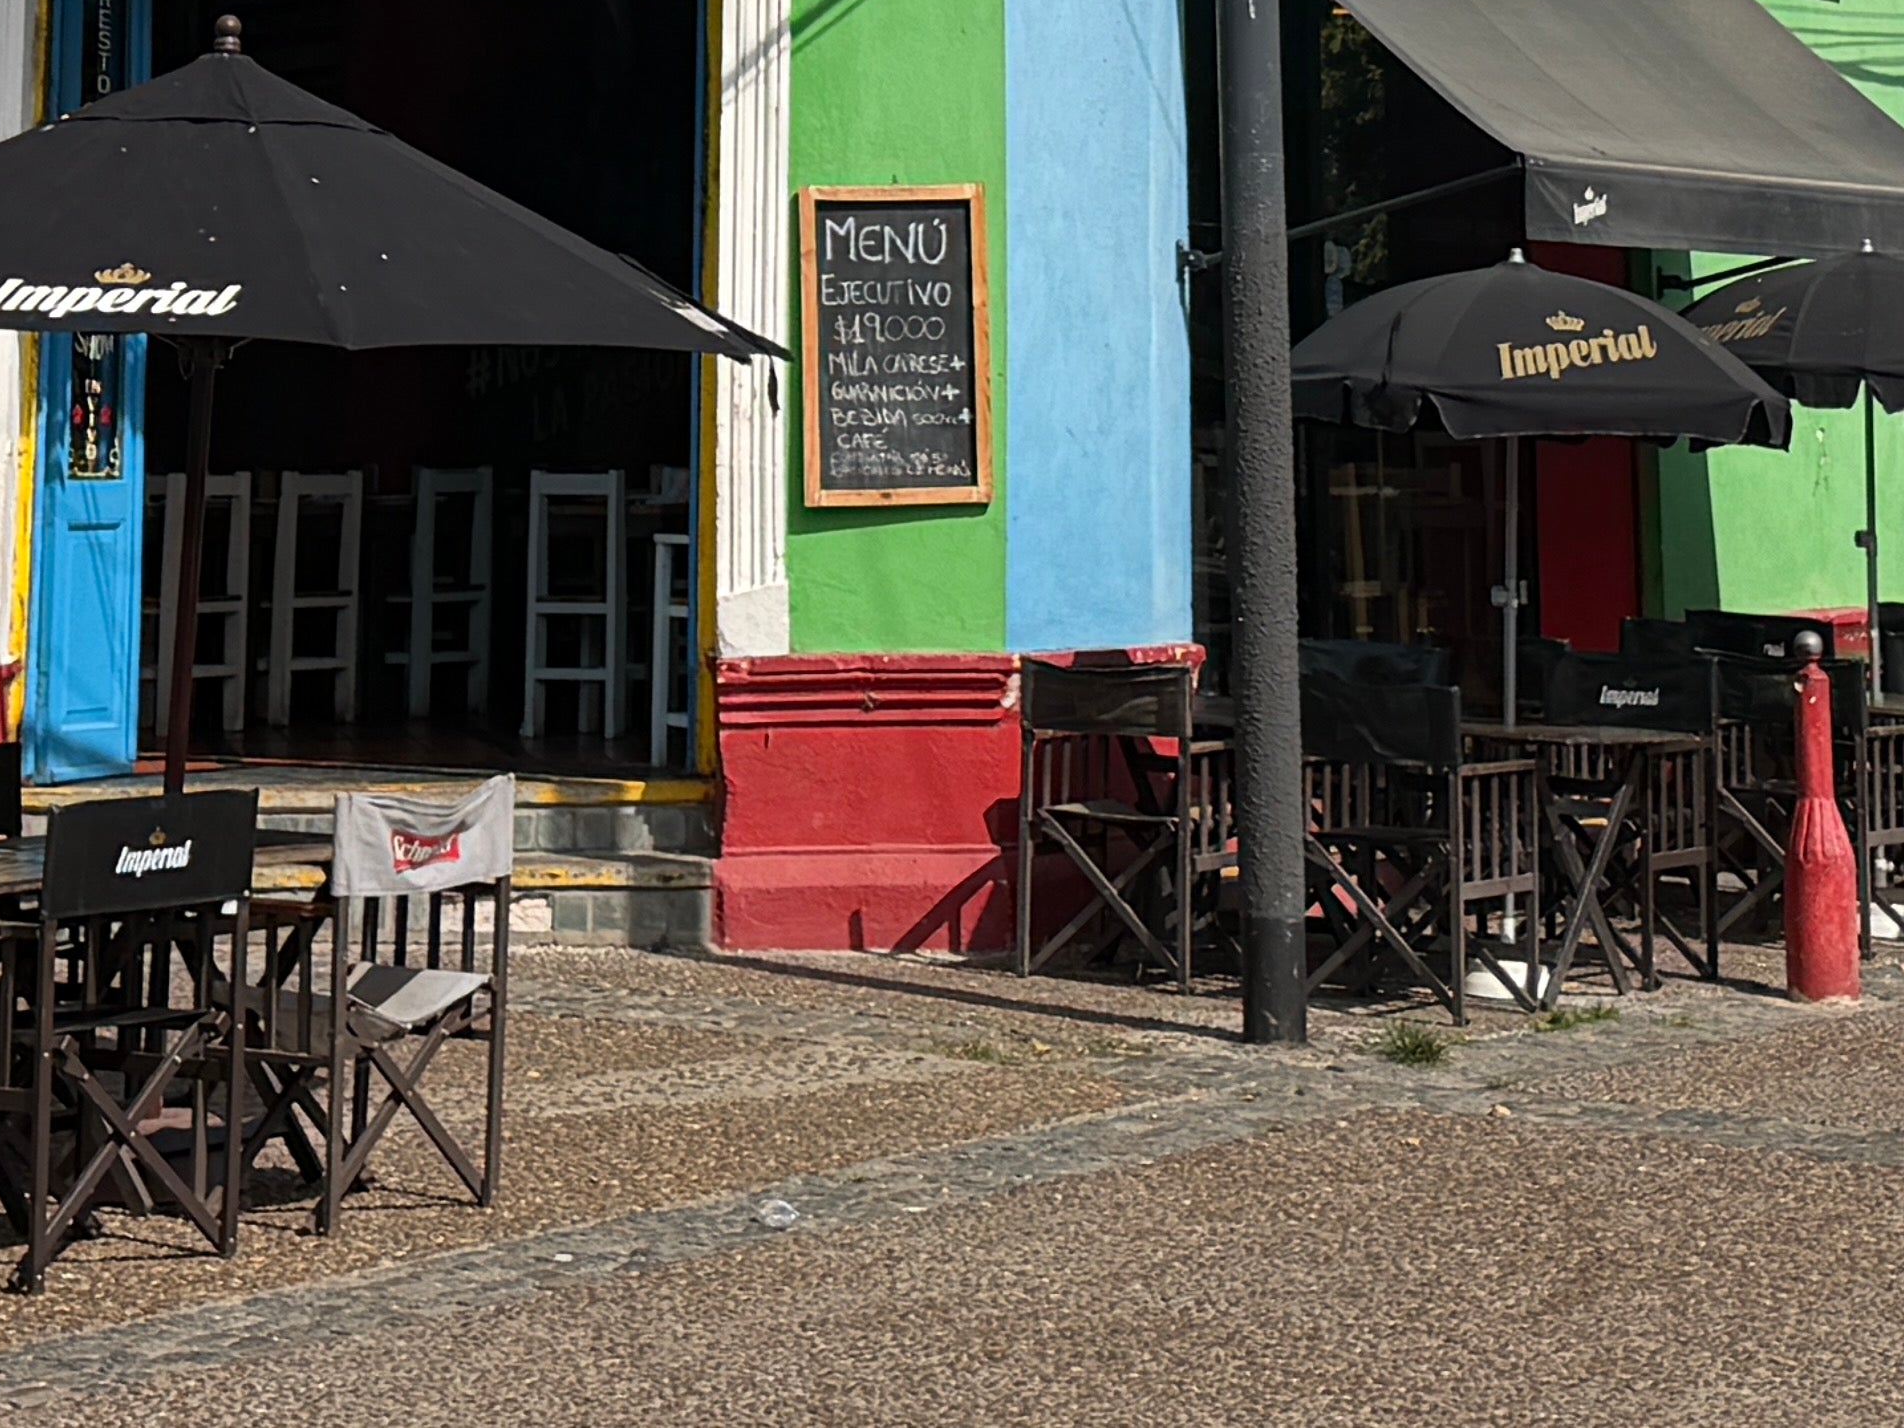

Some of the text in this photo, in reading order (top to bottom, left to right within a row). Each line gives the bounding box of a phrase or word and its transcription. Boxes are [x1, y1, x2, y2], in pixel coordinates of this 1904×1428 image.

[825, 216, 948, 265] MENÚ
[821, 274, 952, 307] EJECUTIVO
[1497, 324, 1657, 380] Imperial
[115, 839, 192, 878] Imperial
